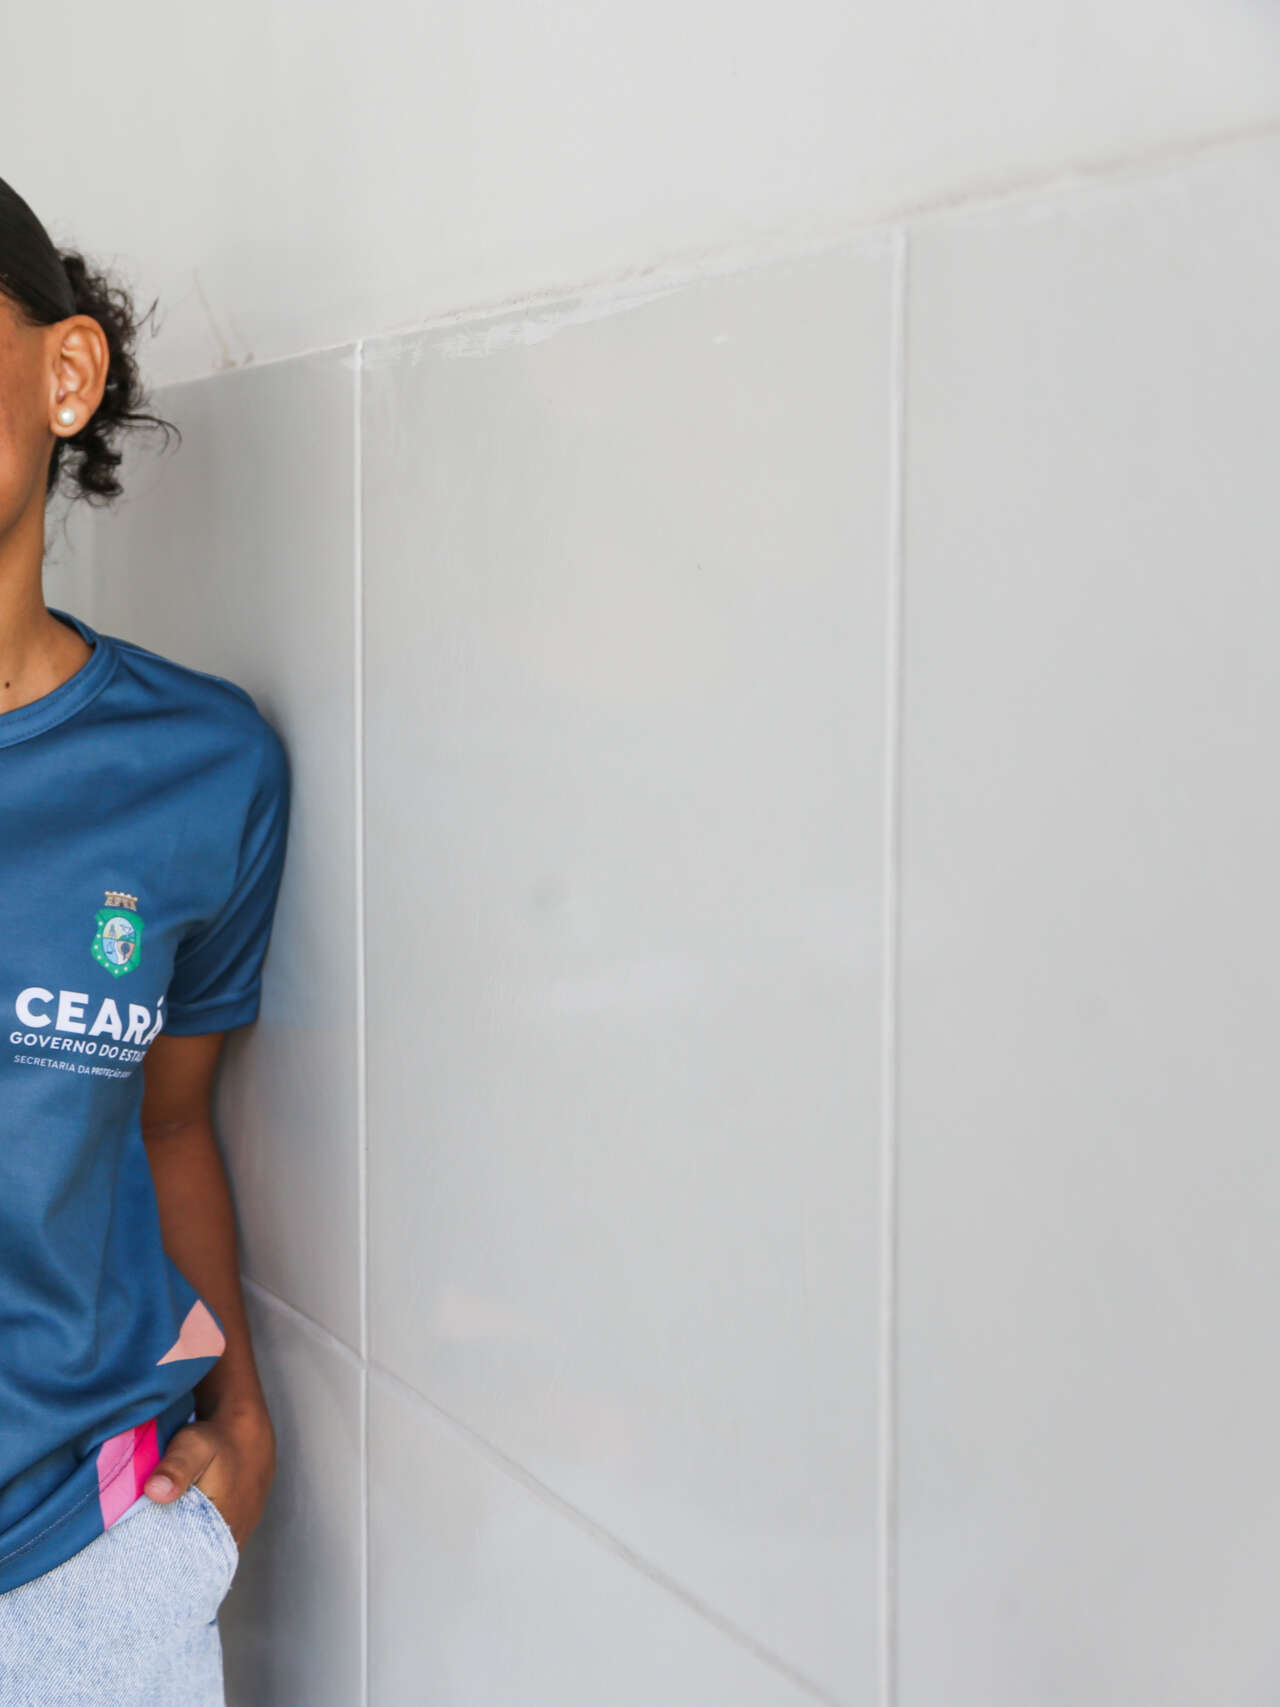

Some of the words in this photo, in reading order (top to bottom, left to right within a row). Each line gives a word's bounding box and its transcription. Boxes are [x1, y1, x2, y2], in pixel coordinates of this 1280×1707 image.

[9, 1031, 98, 1055] GOVERNO
[99, 1044, 119, 1059] DO
[13, 1054, 75, 1073] SECRETARIA
[78, 1064, 90, 1075] DA
